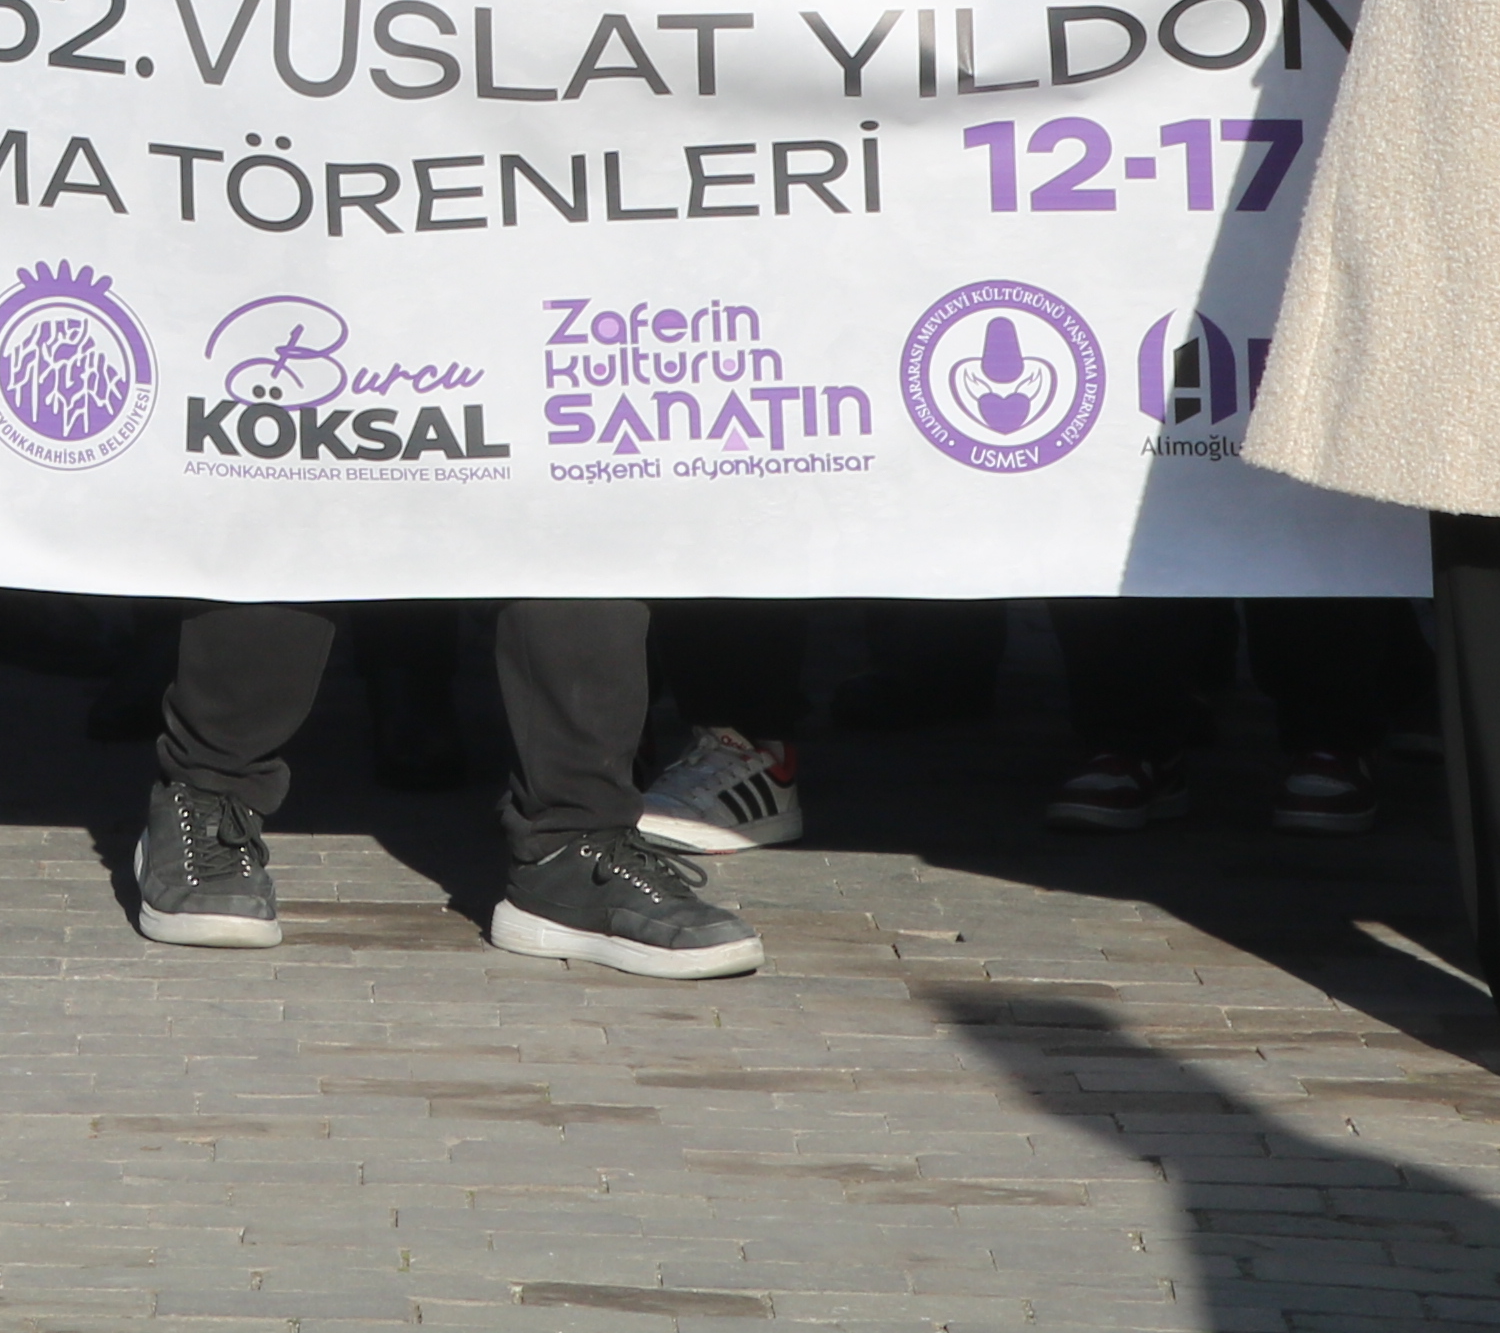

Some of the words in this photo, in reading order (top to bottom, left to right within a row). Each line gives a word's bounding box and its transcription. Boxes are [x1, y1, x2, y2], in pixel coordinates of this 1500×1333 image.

[148, 118, 884, 238] TÖRENLERİ
[963, 118, 1304, 213] 12-17
[543, 298, 760, 345] Zaferin
[921, 293, 971, 344] MEVLEVİ
[971, 286, 1066, 320] KÜLTÜRÜNÜ
[204, 295, 485, 411] Burcu
[1062, 315, 1099, 381] YAŞATMA
[907, 343, 950, 444] ULUSLARARASI
[1061, 383, 1099, 445] DERNEĞİ
[186, 384, 511, 461] KÖKSAL
[434, 466, 511, 484] BAŞKANI
[550, 458, 661, 484] başkenti
[673, 454, 876, 480] afyonkarahisar
[970, 446, 1040, 469] USMEV
